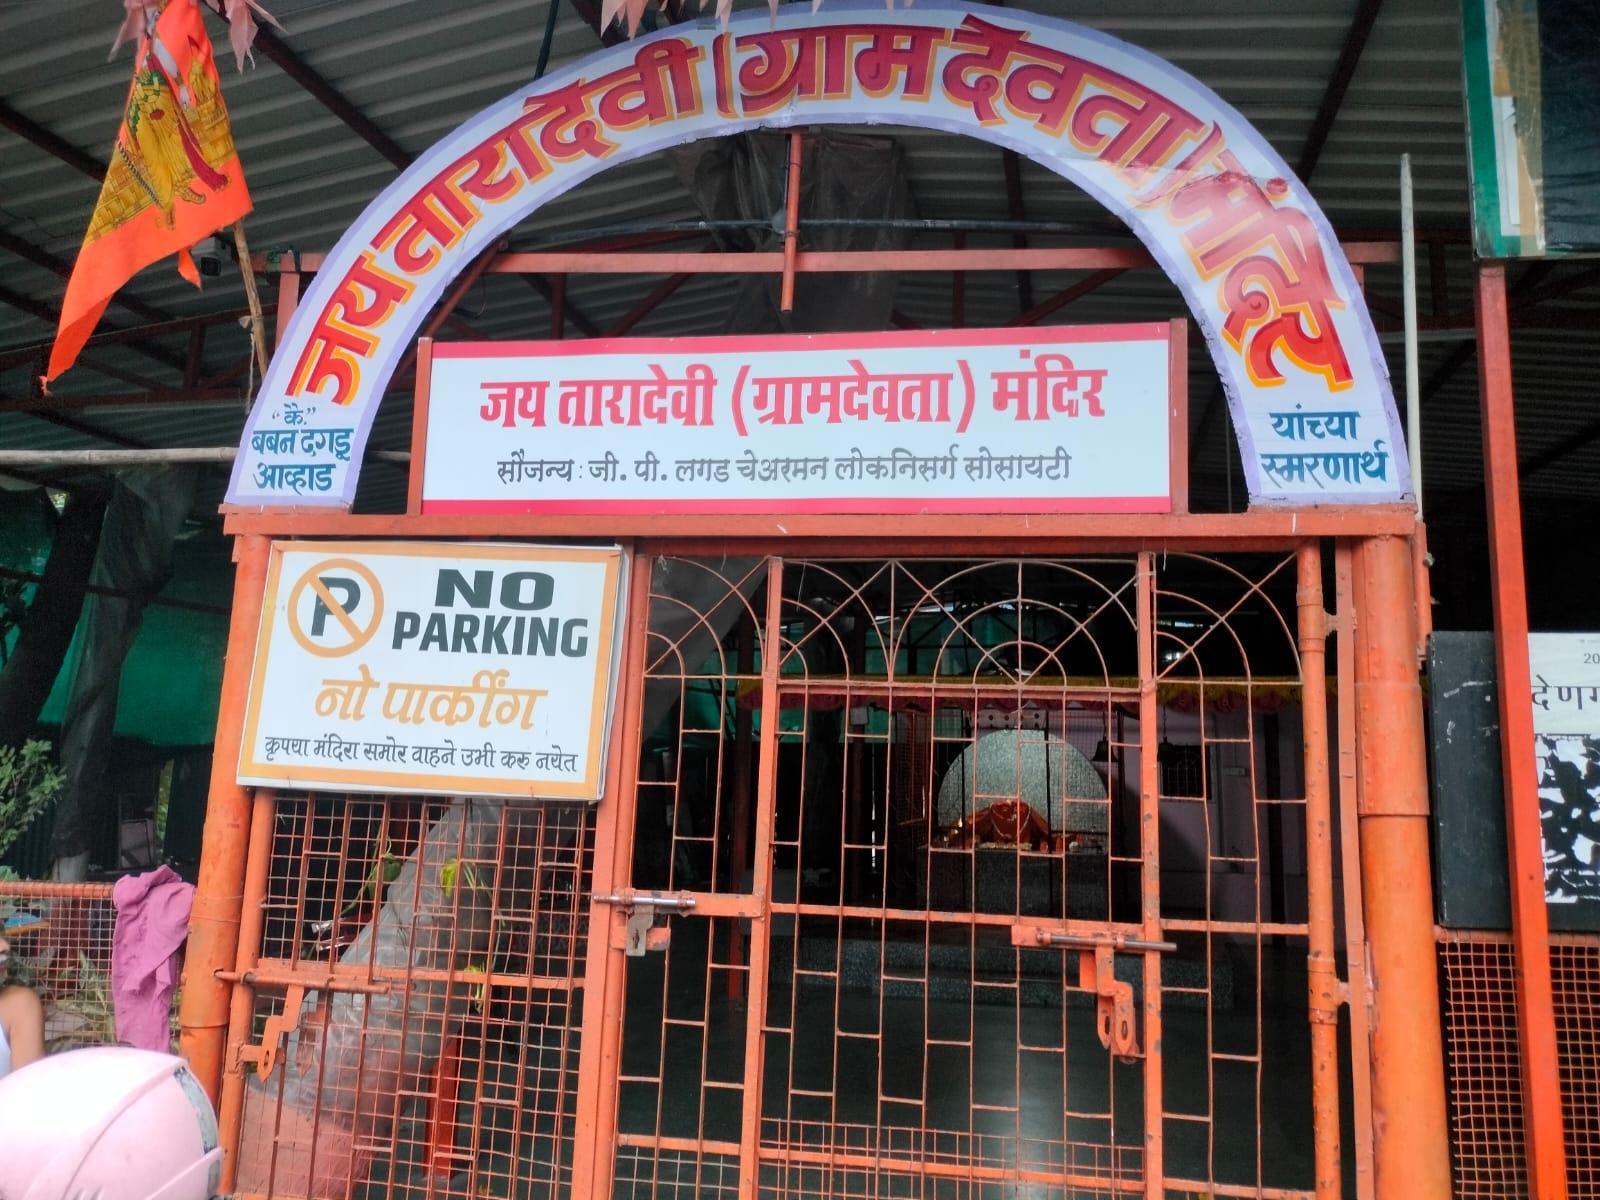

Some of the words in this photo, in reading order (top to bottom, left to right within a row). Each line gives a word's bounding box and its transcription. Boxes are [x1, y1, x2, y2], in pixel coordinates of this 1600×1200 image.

[284, 251, 416, 407] जय
[1165, 148, 1354, 393] मंदिर
[479, 381, 550, 428] जय
[558, 363, 718, 427] तारादेवी
[731, 358, 976, 437] (ग्रामदेवता)
[990, 348, 1109, 422] मंदिर
[251, 429, 299, 455] बबन
[1268, 402, 1361, 441] यांच्या
[253, 461, 337, 496] आव्हाड
[588, 450, 628, 483] जी.
[634, 449, 668, 483] पी.
[674, 457, 731, 483] लगड
[735, 448, 830, 484] चेअरमन
[835, 443, 960, 482] लोकनिसर्ग
[963, 445, 1073, 482] सोसायटी
[1260, 439, 1389, 489] स्मरणार्थ
[433, 568, 556, 611] NO
[391, 610, 589, 658] PARKING
[314, 663, 381, 721] नो
[264, 736, 311, 762] कृपया
[313, 732, 361, 763] मंदिरा
[362, 735, 409, 764] समोर
[411, 738, 458, 768] वाहने
[535, 744, 579, 773] नयेत
